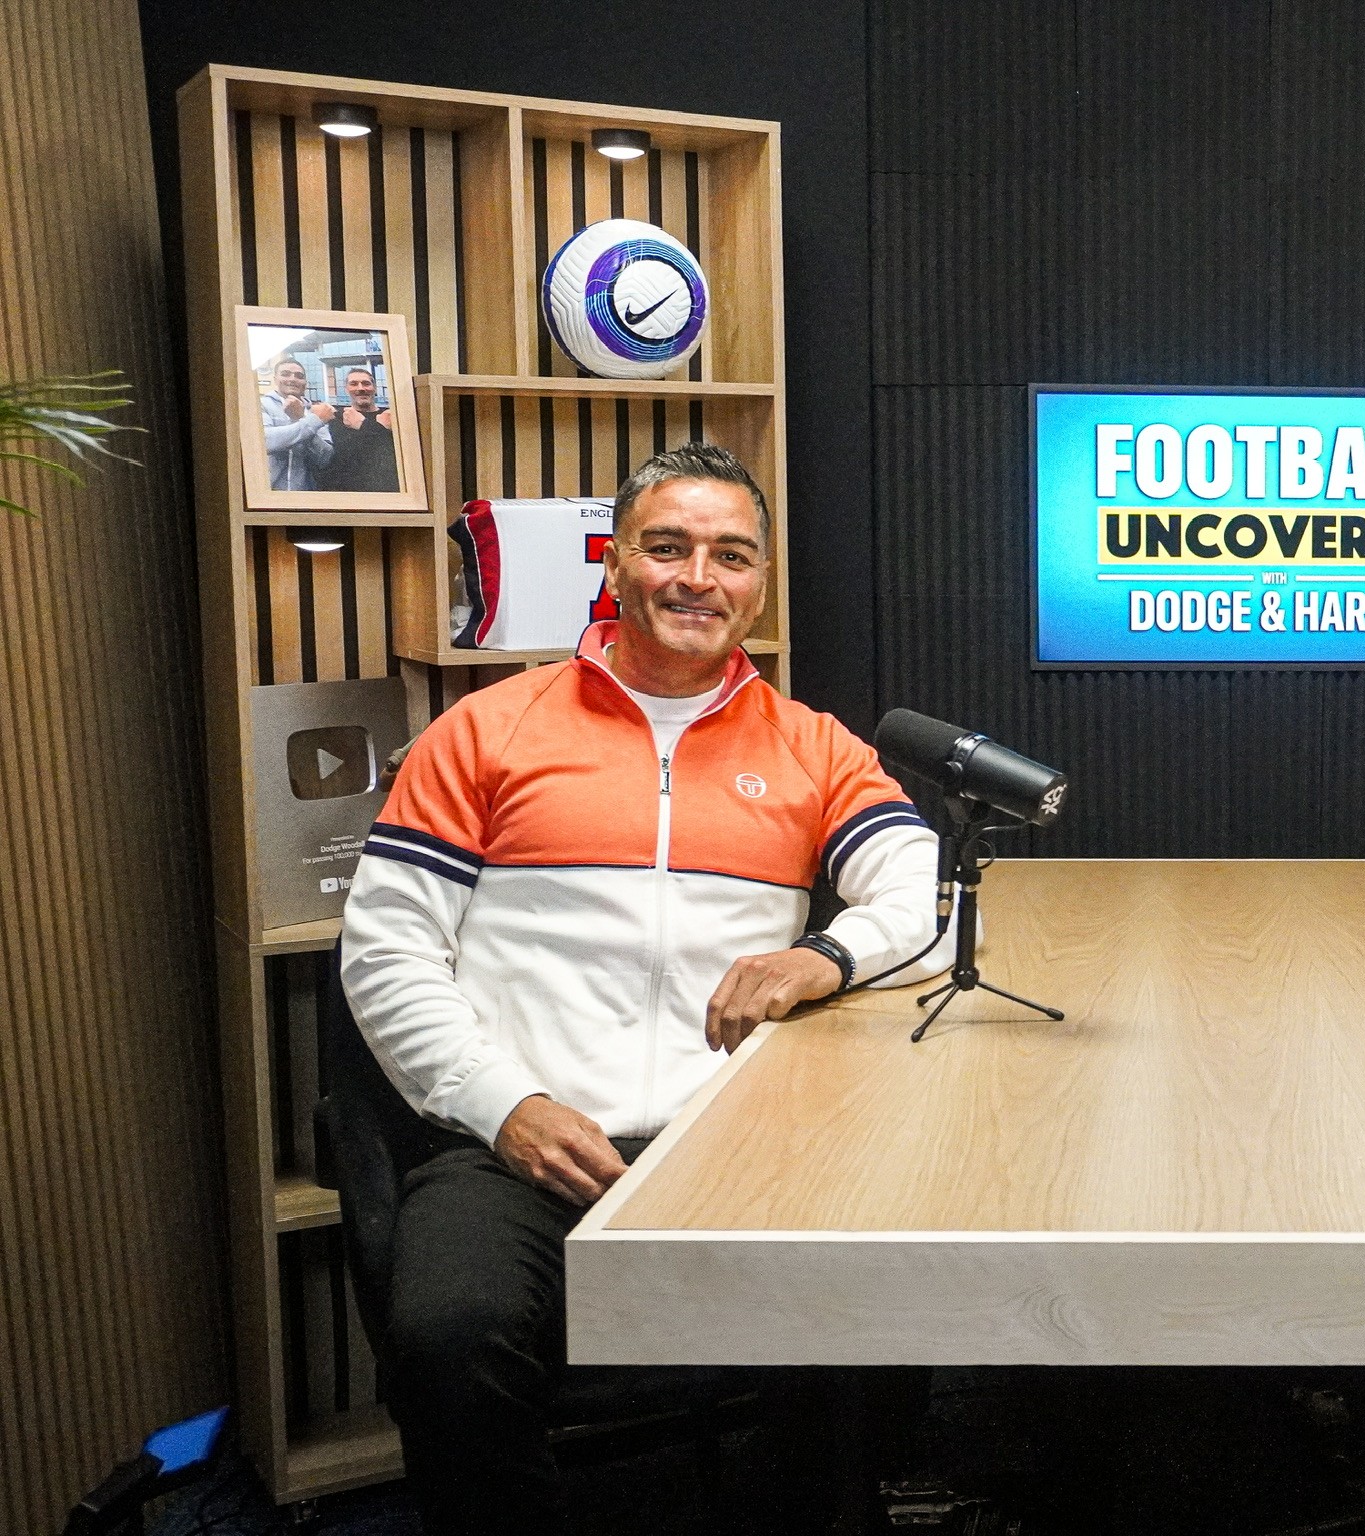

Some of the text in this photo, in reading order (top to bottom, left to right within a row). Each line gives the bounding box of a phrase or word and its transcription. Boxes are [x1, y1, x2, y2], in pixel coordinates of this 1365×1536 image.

[580, 508, 613, 518] ENGL
[1261, 571, 1287, 585] WITH
[1129, 590, 1252, 632] DODGE
[1260, 592, 1286, 632] &
